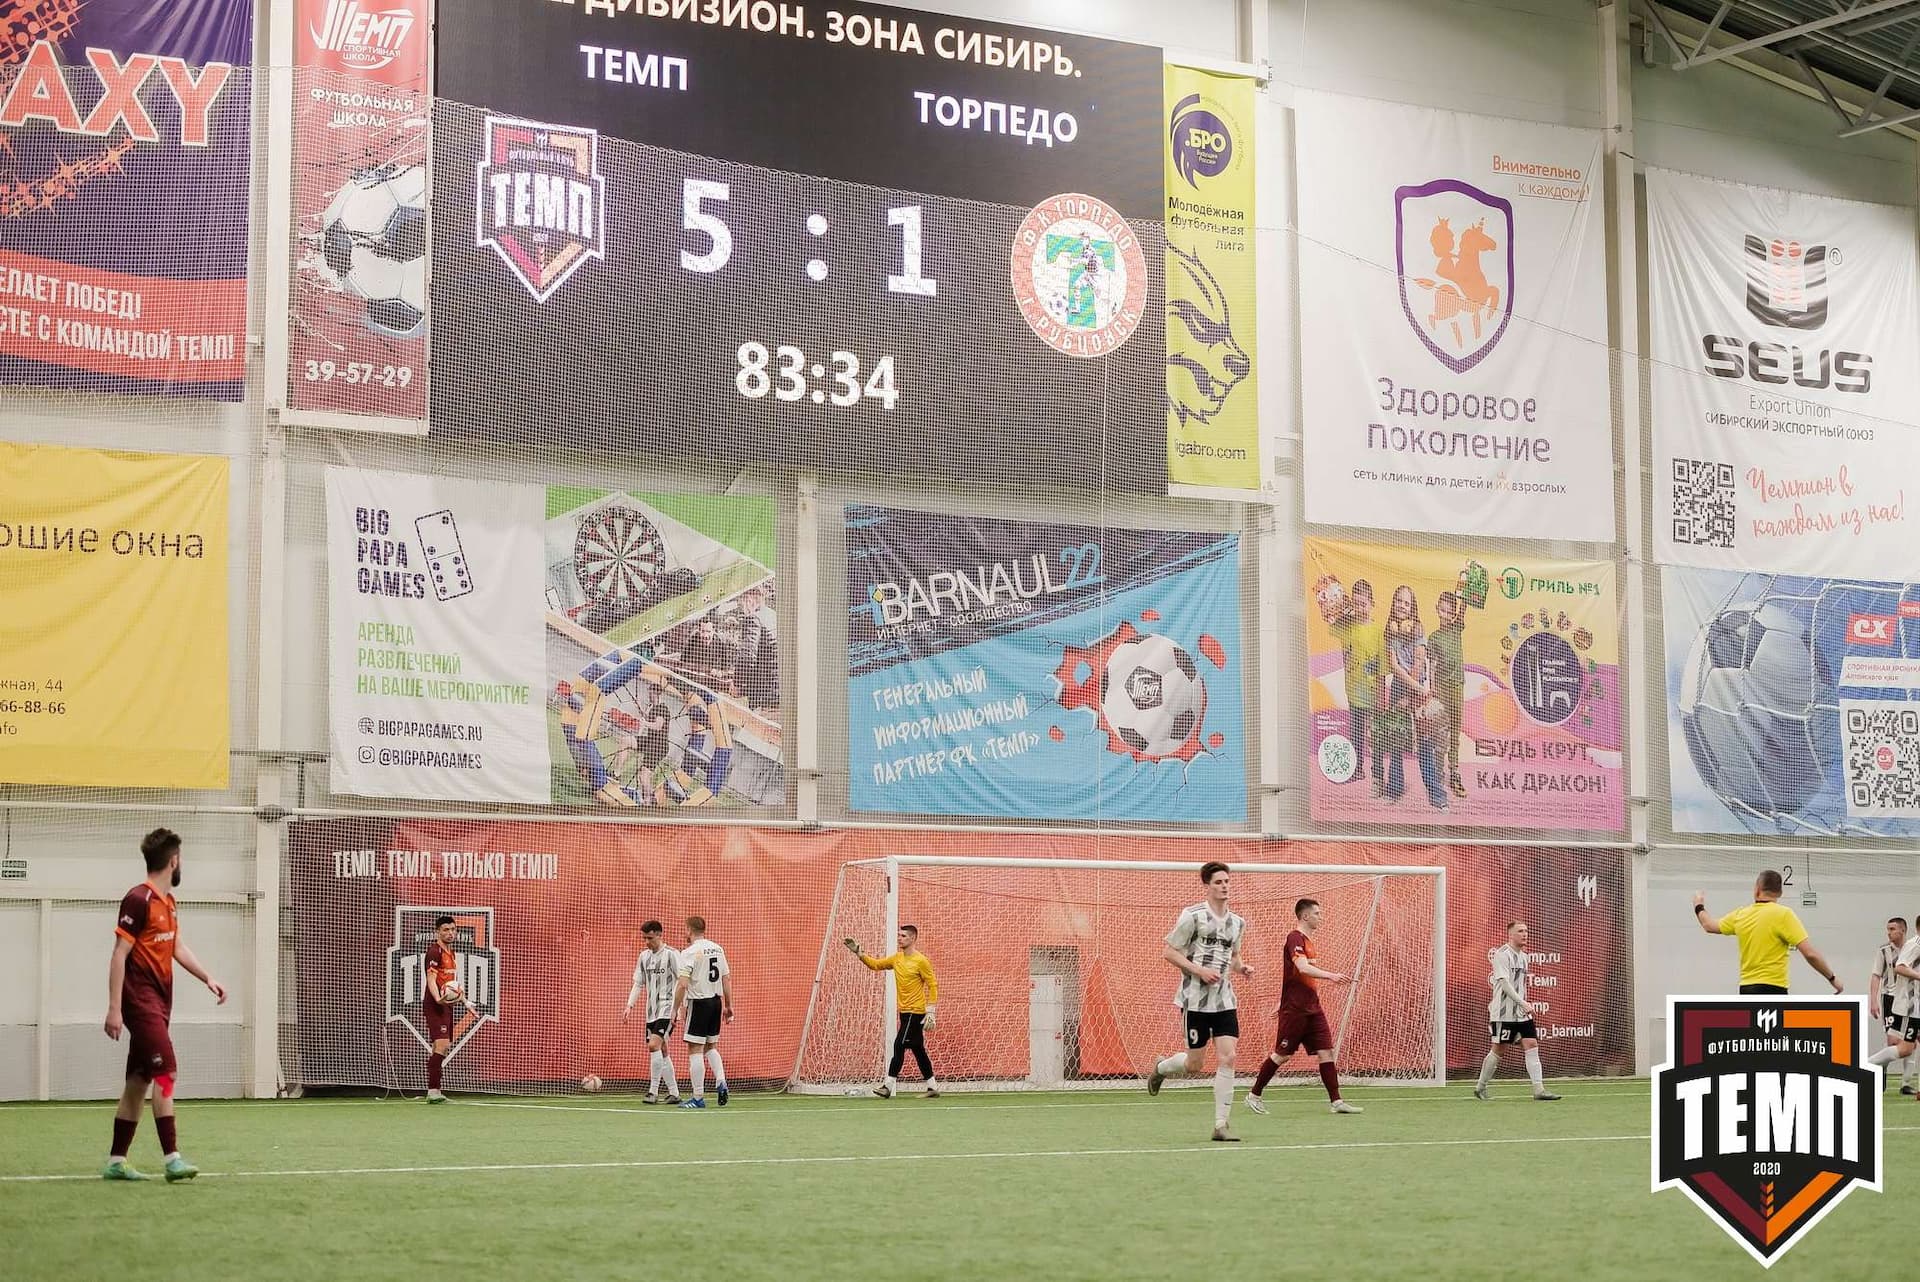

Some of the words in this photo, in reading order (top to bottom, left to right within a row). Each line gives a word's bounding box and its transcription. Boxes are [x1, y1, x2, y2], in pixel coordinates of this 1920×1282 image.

[343, 44, 401, 58] СПОРТИВНАЯ
[343, 53, 377, 62] ШКОЛА
[825, 10, 924, 57] ЗОНА
[934, 29, 1083, 78] СИБИРЬ.
[580, 44, 689, 91] ТЕМП
[311, 88, 414, 112] ФУТБОЛЬНАЯ
[333, 110, 387, 128] ШКОЛА
[914, 91, 1078, 147] ТОРПЕДО
[1493, 155, 1581, 180] Внимательно
[490, 172, 593, 240] ТЕМП
[1169, 196, 1244, 221] Молодёжная
[681, 178, 733, 275] 5
[887, 204, 937, 297] 1
[1054, 199, 1132, 250] ТОРПЕДО
[1171, 213, 1244, 236] футбольная
[1216, 238, 1244, 252] лига
[66, 281, 142, 320] ПОБЕД!
[39, 314, 51, 341] С
[58, 318, 172, 360] КОМАНДОЙ
[178, 334, 235, 361] ТЕМП!
[305, 360, 413, 388] 39-57-29
[735, 341, 899, 410] 83:34
[1703, 333, 1873, 394] SEUS
[1377, 377, 1537, 424] Здоровое
[1750, 395, 1792, 414] Export
[1795, 400, 1831, 418] Union
[1705, 411, 1769, 431] СИБИРСКИЙ
[1772, 420, 1844, 438] ЭКСПОРТНЫЙ
[1846, 428, 1874, 441] СОЮЗ
[1367, 421, 1552, 465] поколение
[1353, 468, 1378, 481] сеть
[1381, 472, 1423, 485] клиник
[1426, 475, 1447, 488] для
[1449, 476, 1484, 490] детей
[1512, 482, 1568, 495] взрослых
[1745, 467, 1836, 504] Чемпион
[1839, 464, 1854, 497] в
[355, 506, 389, 536] BIG
[1753, 503, 1838, 538] каждом
[1841, 508, 1864, 535] из
[1868, 489, 1904, 523] нас!
[112, 530, 205, 559] окна
[357, 537, 408, 569] PAPA
[357, 567, 426, 600] GAMES
[1530, 578, 1575, 594] ГРИЛЬ
[1578, 581, 1600, 596] №1
[358, 622, 415, 646] АРЕНДА
[358, 648, 461, 675] РАЗВЛЕЧЕНИЙ
[45, 678, 63, 692] 44
[357, 675, 377, 695] НА
[381, 676, 424, 698] ВАШЕ
[427, 679, 529, 705] МЕРОПРИЯТИЕ
[872, 664, 987, 712] ГЕНЕРАЛЬНЫЙ
[0, 721, 18, 735] fo
[378, 719, 483, 742] BIGPAPAGAMES.RU
[873, 691, 1029, 751] ИНФОРМАЦИОННЫЙ
[379, 748, 483, 770] @BIGPAPAGAMES
[873, 750, 946, 786] ПАРТНЕР
[950, 743, 978, 769] ФК
[981, 730, 1041, 761] «ТЕМП»
[1475, 738, 1537, 762] БУДЬ
[1542, 740, 1594, 765] КРУТ,
[1476, 770, 1517, 790] КАК
[1521, 772, 1607, 795] ДРАКОН!
[332, 850, 381, 880] ТЕМП,
[387, 850, 437, 881] ТЕМП,
[441, 851, 505, 879] ТОЛЬКО
[509, 852, 558, 880] ТЕМП!
[1783, 865, 1793, 886] 2
[400, 953, 488, 1005] ТП
[709, 957, 720, 983] 5
[1189, 1028, 1199, 1045] 9
[1906, 1027, 1914, 1039] 2
